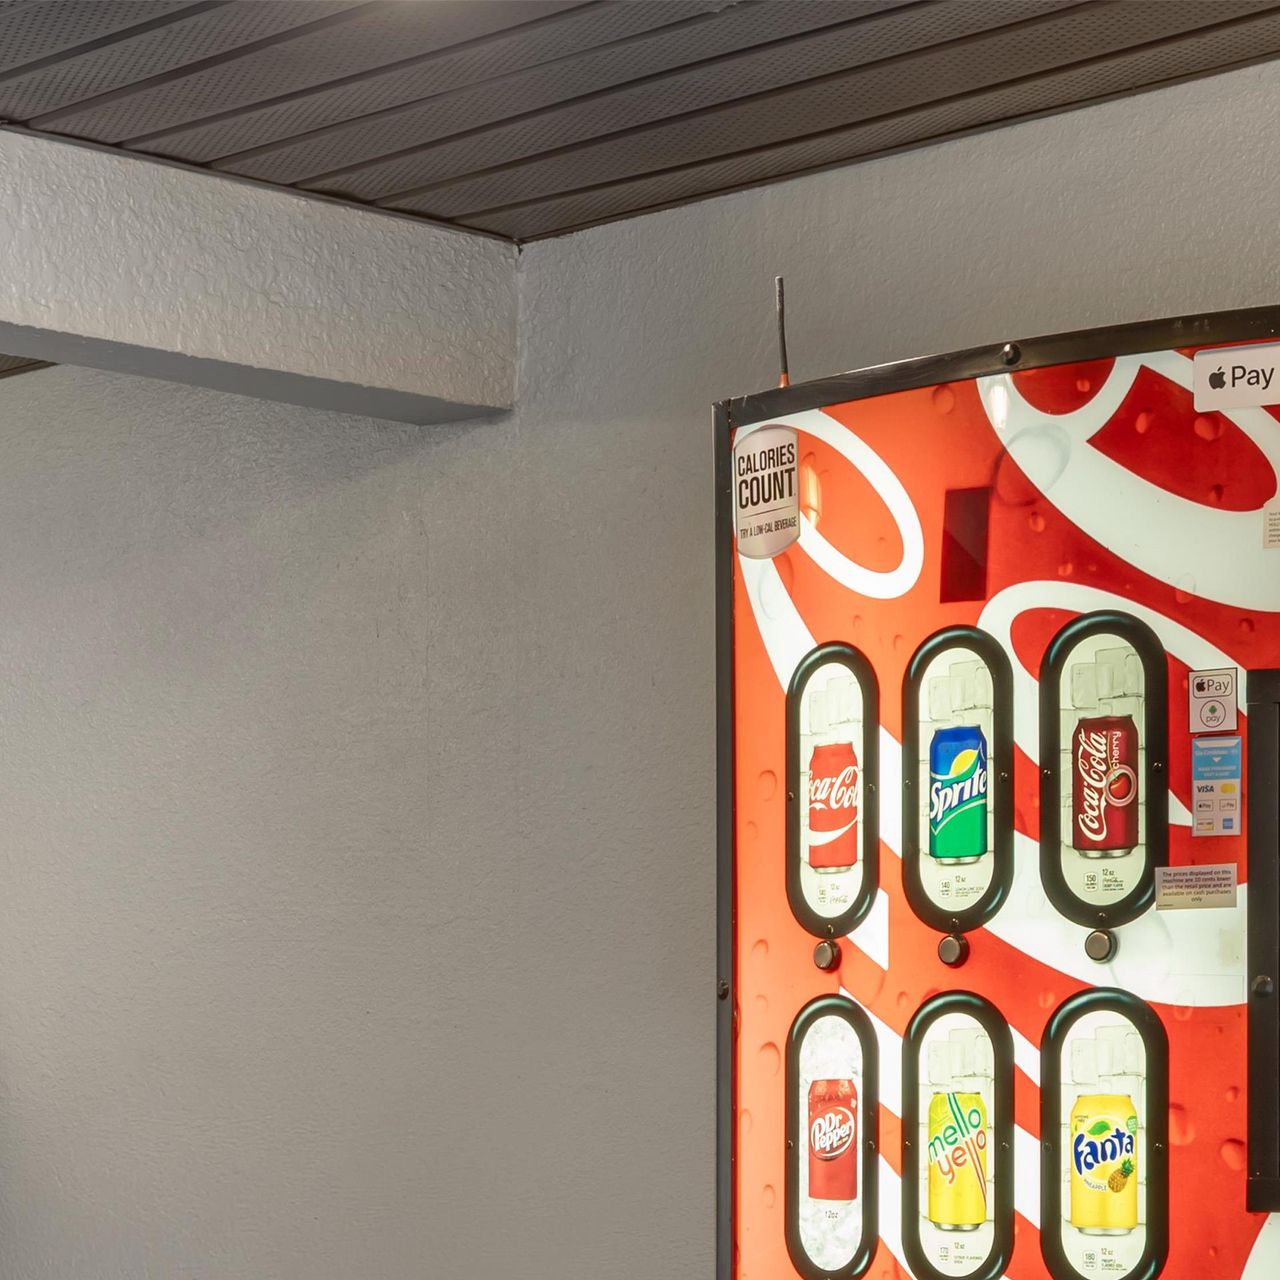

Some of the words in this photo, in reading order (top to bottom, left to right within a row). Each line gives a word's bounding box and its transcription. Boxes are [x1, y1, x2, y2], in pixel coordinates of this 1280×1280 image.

[1231, 365, 1275, 390] Pay
[738, 442, 795, 477] CALORIES
[738, 467, 796, 509] COUNT
[740, 528, 749, 539] TRY
[753, 521, 774, 536] LOW-CAL
[774, 516, 797, 533] BEVERAGE
[1207, 679, 1229, 694] Pay
[1206, 715, 1220, 723] pay
[1112, 731, 1122, 769] cherry
[930, 763, 987, 823] Sprite
[1078, 728, 1107, 841] Coca-Cola
[1197, 785, 1214, 793] VISA
[1086, 874, 1096, 882] 150
[1102, 868, 1108, 876] 12
[814, 1117, 853, 1151] Pepper
[825, 1112, 842, 1134] Dr
[928, 1092, 981, 1163] mello
[937, 1129, 987, 1204] yello
